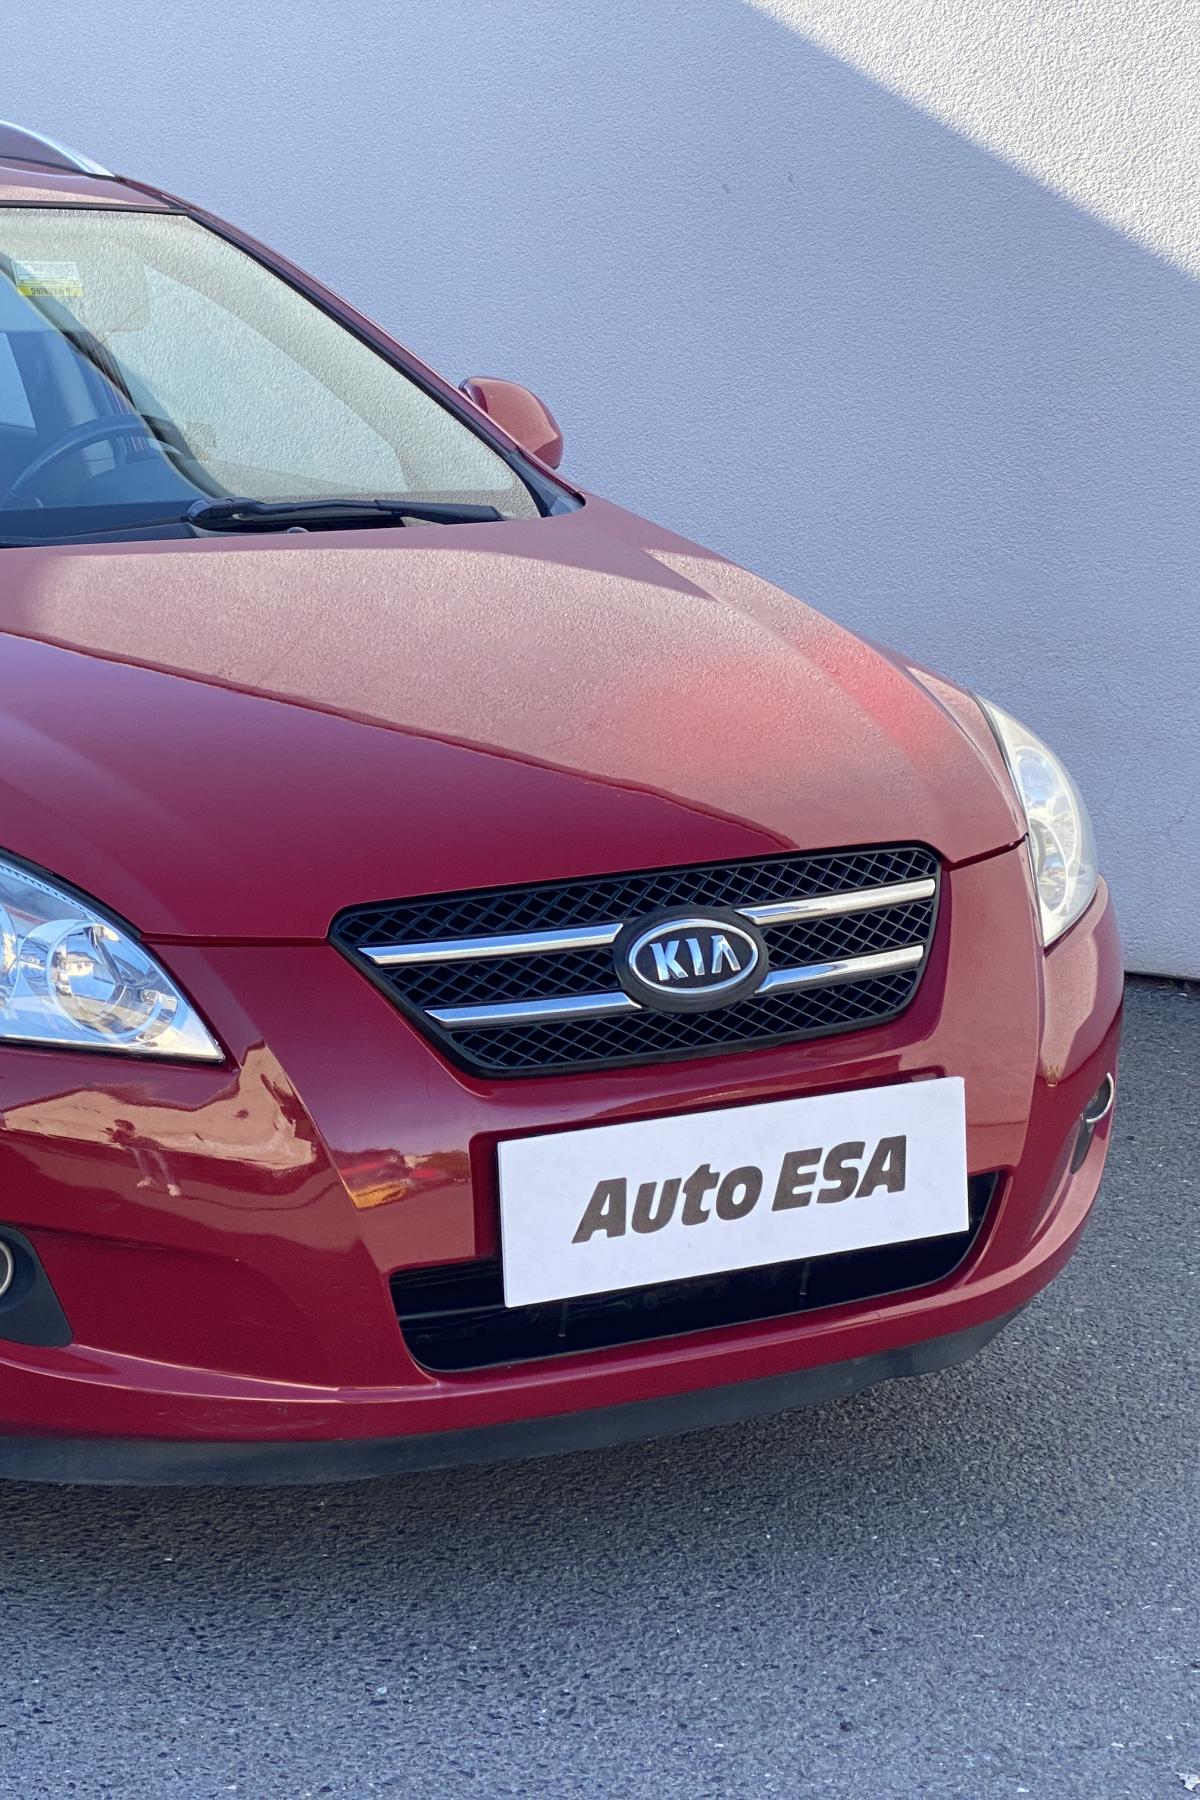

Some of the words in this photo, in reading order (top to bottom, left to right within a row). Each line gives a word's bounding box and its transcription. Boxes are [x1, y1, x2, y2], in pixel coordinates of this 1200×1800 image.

[650, 934, 741, 981] KIA
[571, 1163, 763, 1244] Auto
[771, 1134, 907, 1213] ESA
